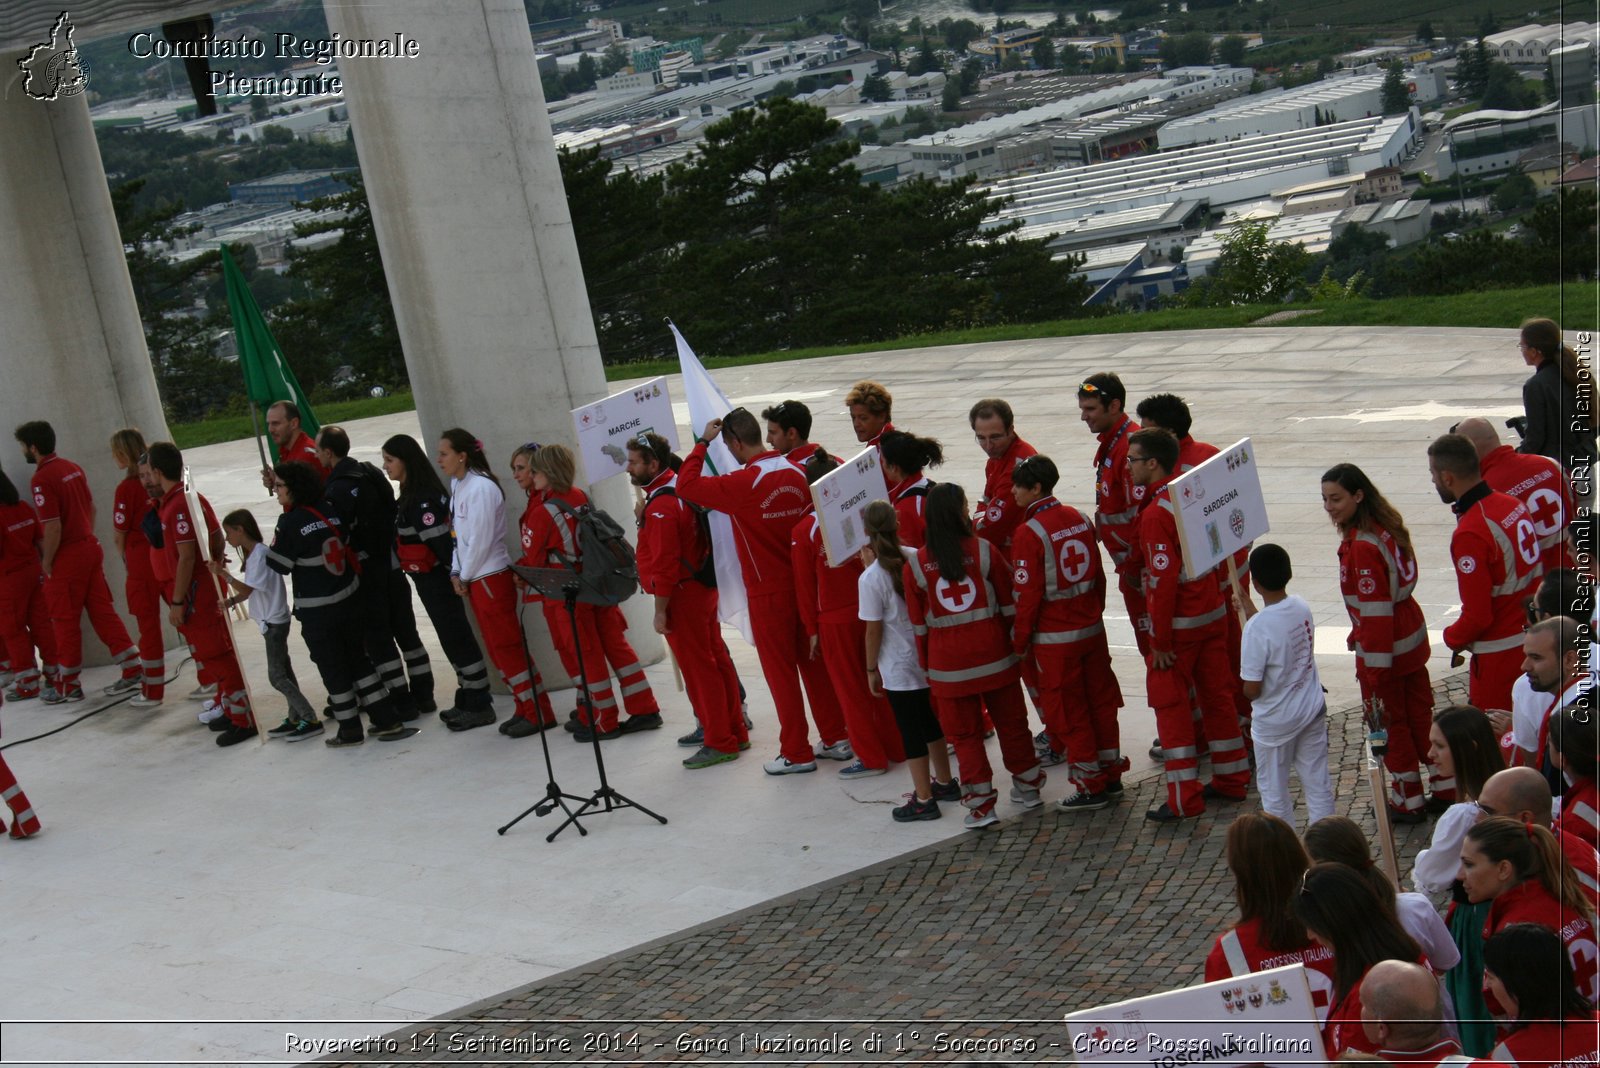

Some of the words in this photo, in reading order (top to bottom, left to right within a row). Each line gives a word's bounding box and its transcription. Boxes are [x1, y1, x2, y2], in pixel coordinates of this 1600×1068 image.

[608, 417, 641, 437] MARCHE
[840, 489, 868, 513] PIEMONTE
[1203, 488, 1239, 517] SARDEGNA
[762, 510, 786, 519] REGIONE
[300, 521, 318, 536] CROCE
[1260, 955, 1283, 971] CROCE
[1282, 951, 1304, 967] ROSSA
[1149, 1041, 1242, 1068] TOSCANA
